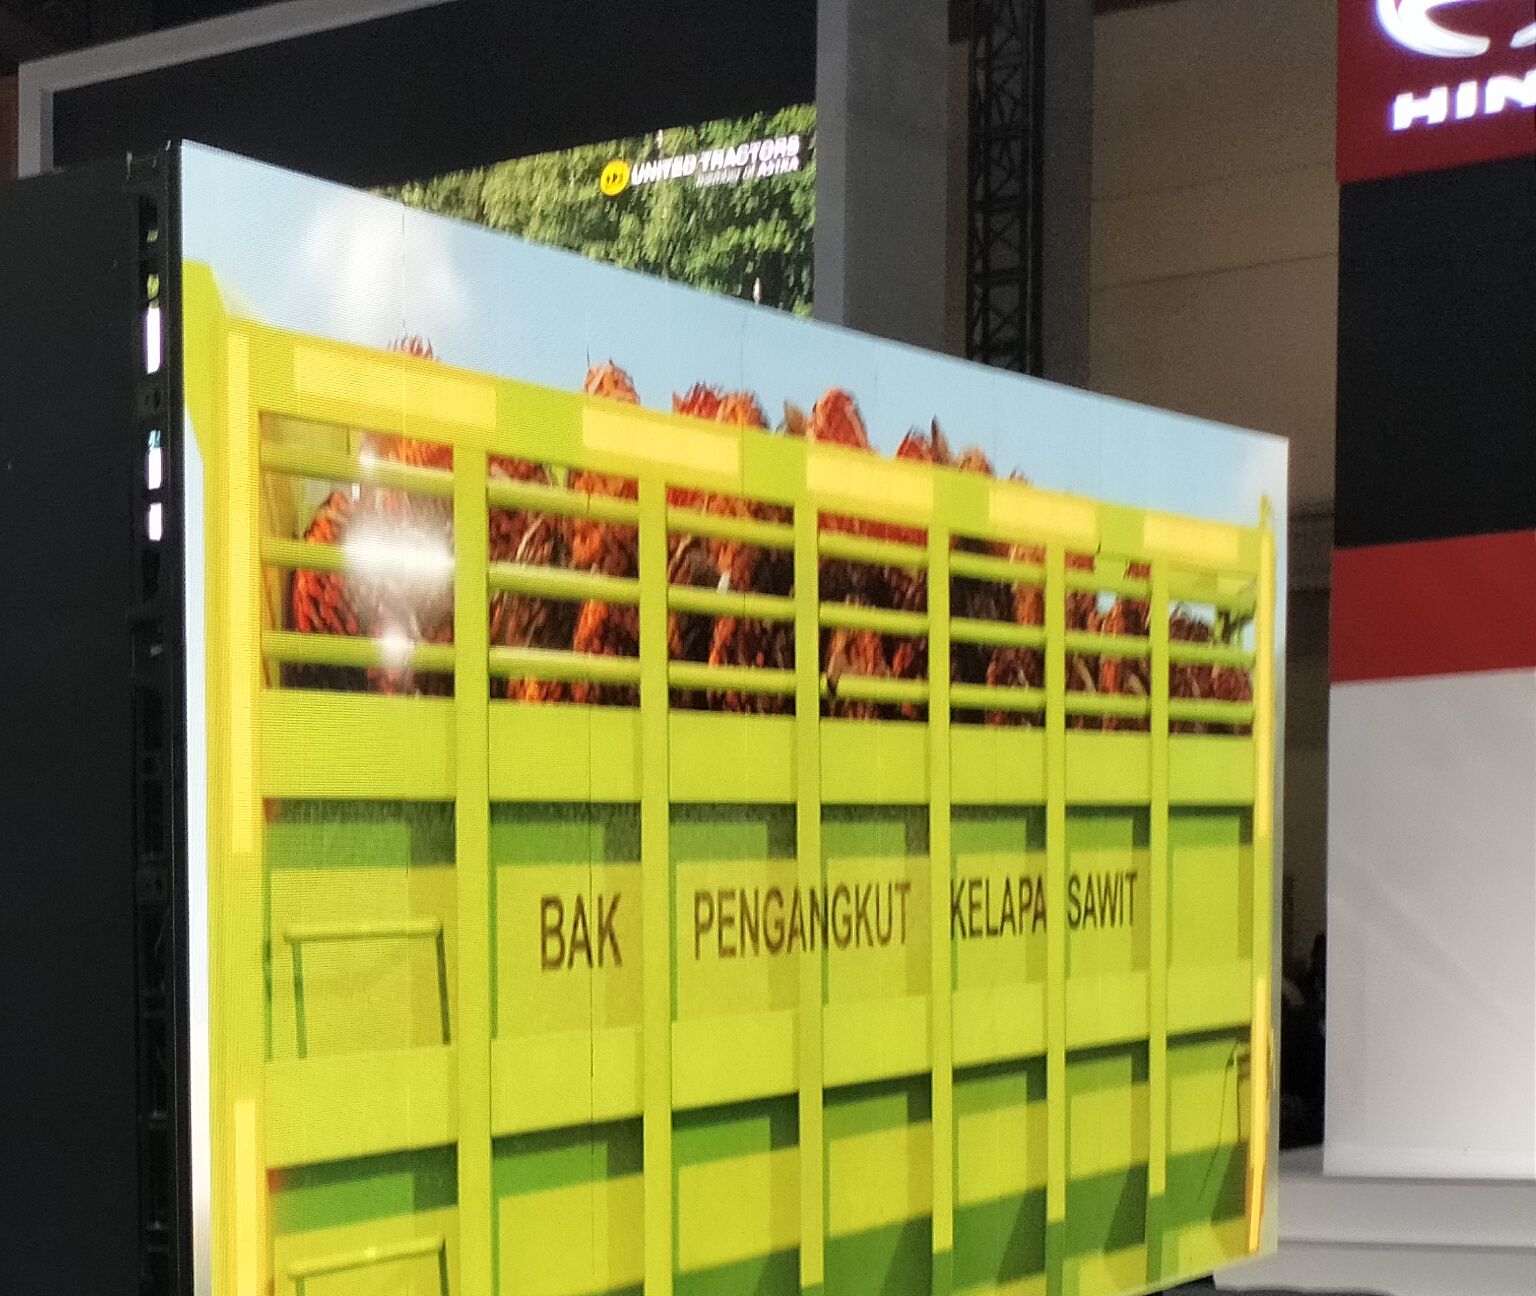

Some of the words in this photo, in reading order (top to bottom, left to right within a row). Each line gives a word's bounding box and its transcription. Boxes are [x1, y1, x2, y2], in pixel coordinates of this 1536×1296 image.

[631, 154, 697, 186] UNITED
[697, 134, 800, 173] TRACTORS
[539, 891, 624, 973] BAK
[693, 880, 913, 961] PENGANGKUT
[949, 872, 1049, 940] KELAPA
[1066, 869, 1139, 931] SAWIT
